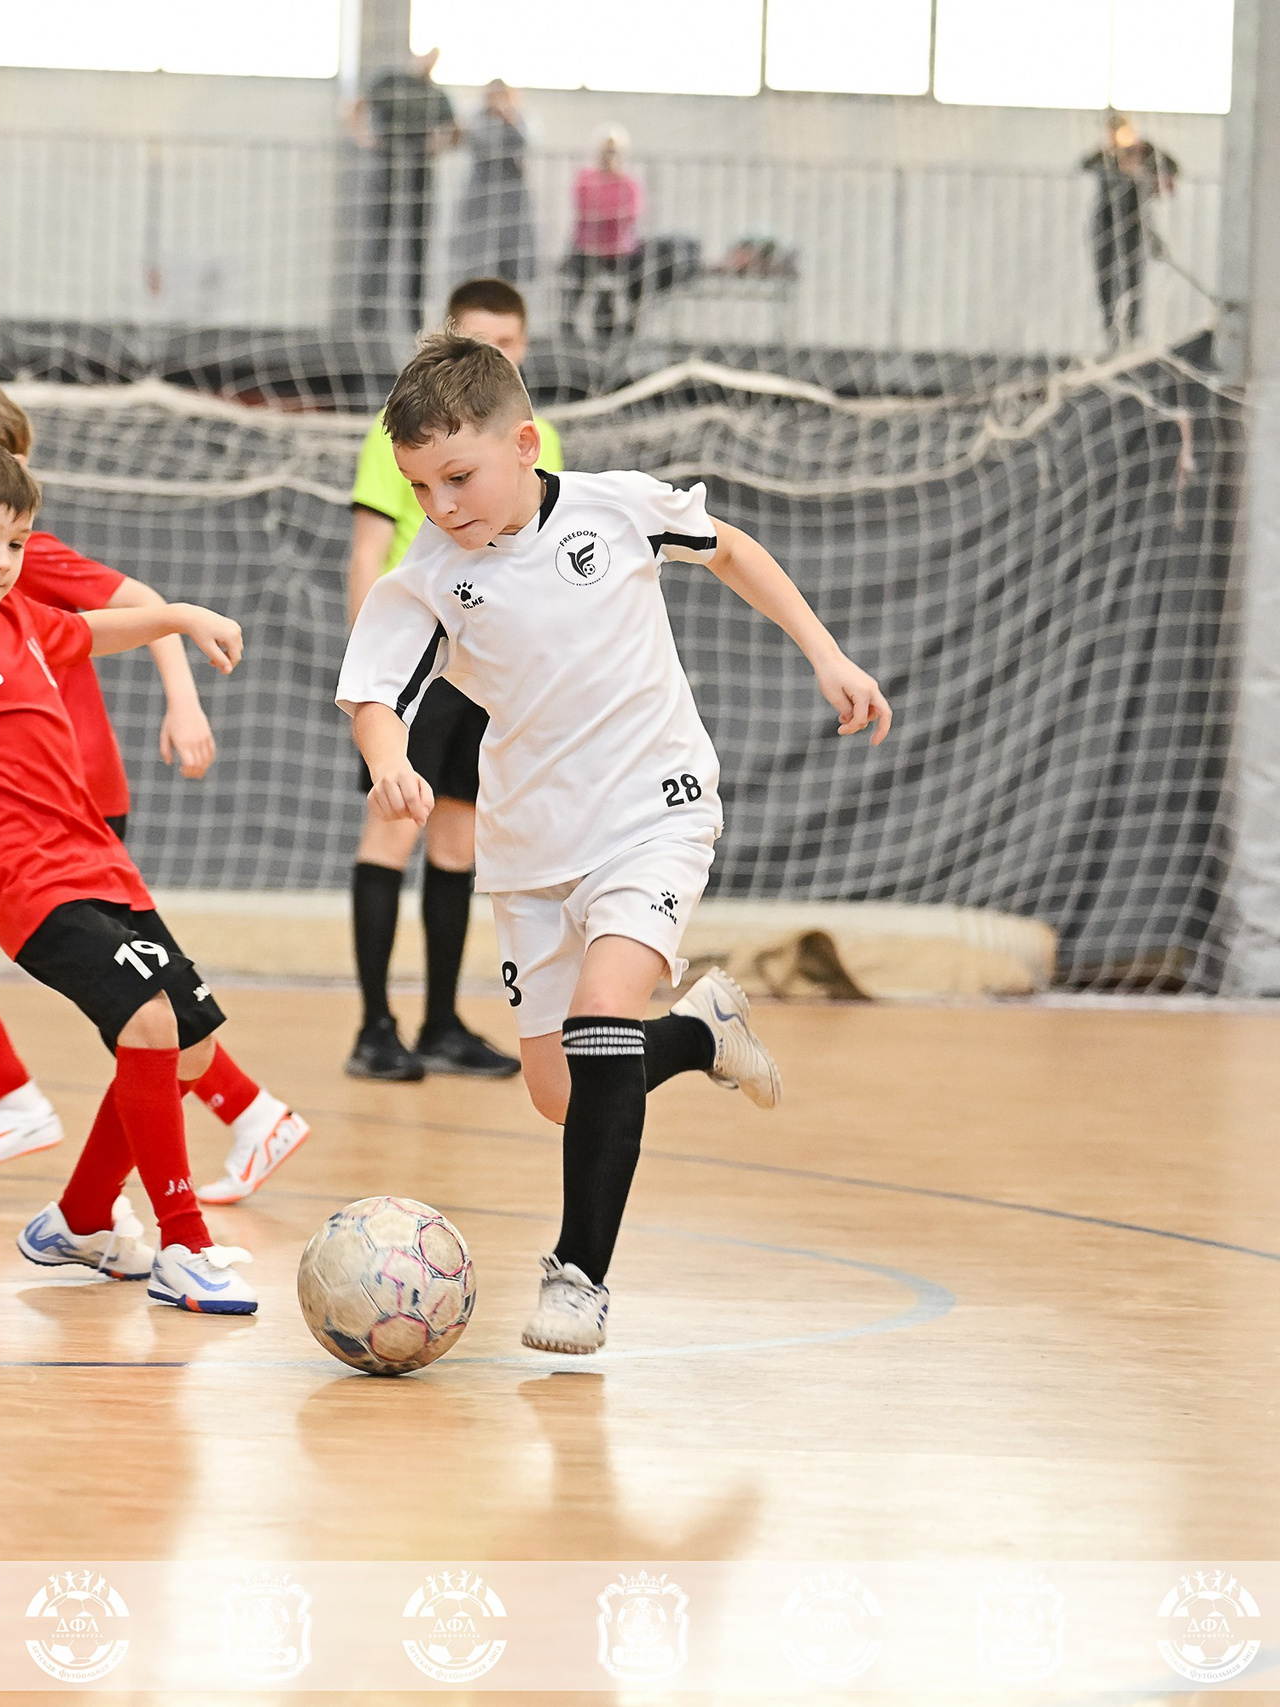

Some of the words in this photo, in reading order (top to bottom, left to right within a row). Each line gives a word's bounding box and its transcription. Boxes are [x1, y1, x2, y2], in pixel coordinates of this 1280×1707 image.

[559, 530, 598, 547] FREEDOM
[661, 773, 702, 807] 28
[650, 903, 677, 925] KELME
[113, 940, 170, 980] 19
